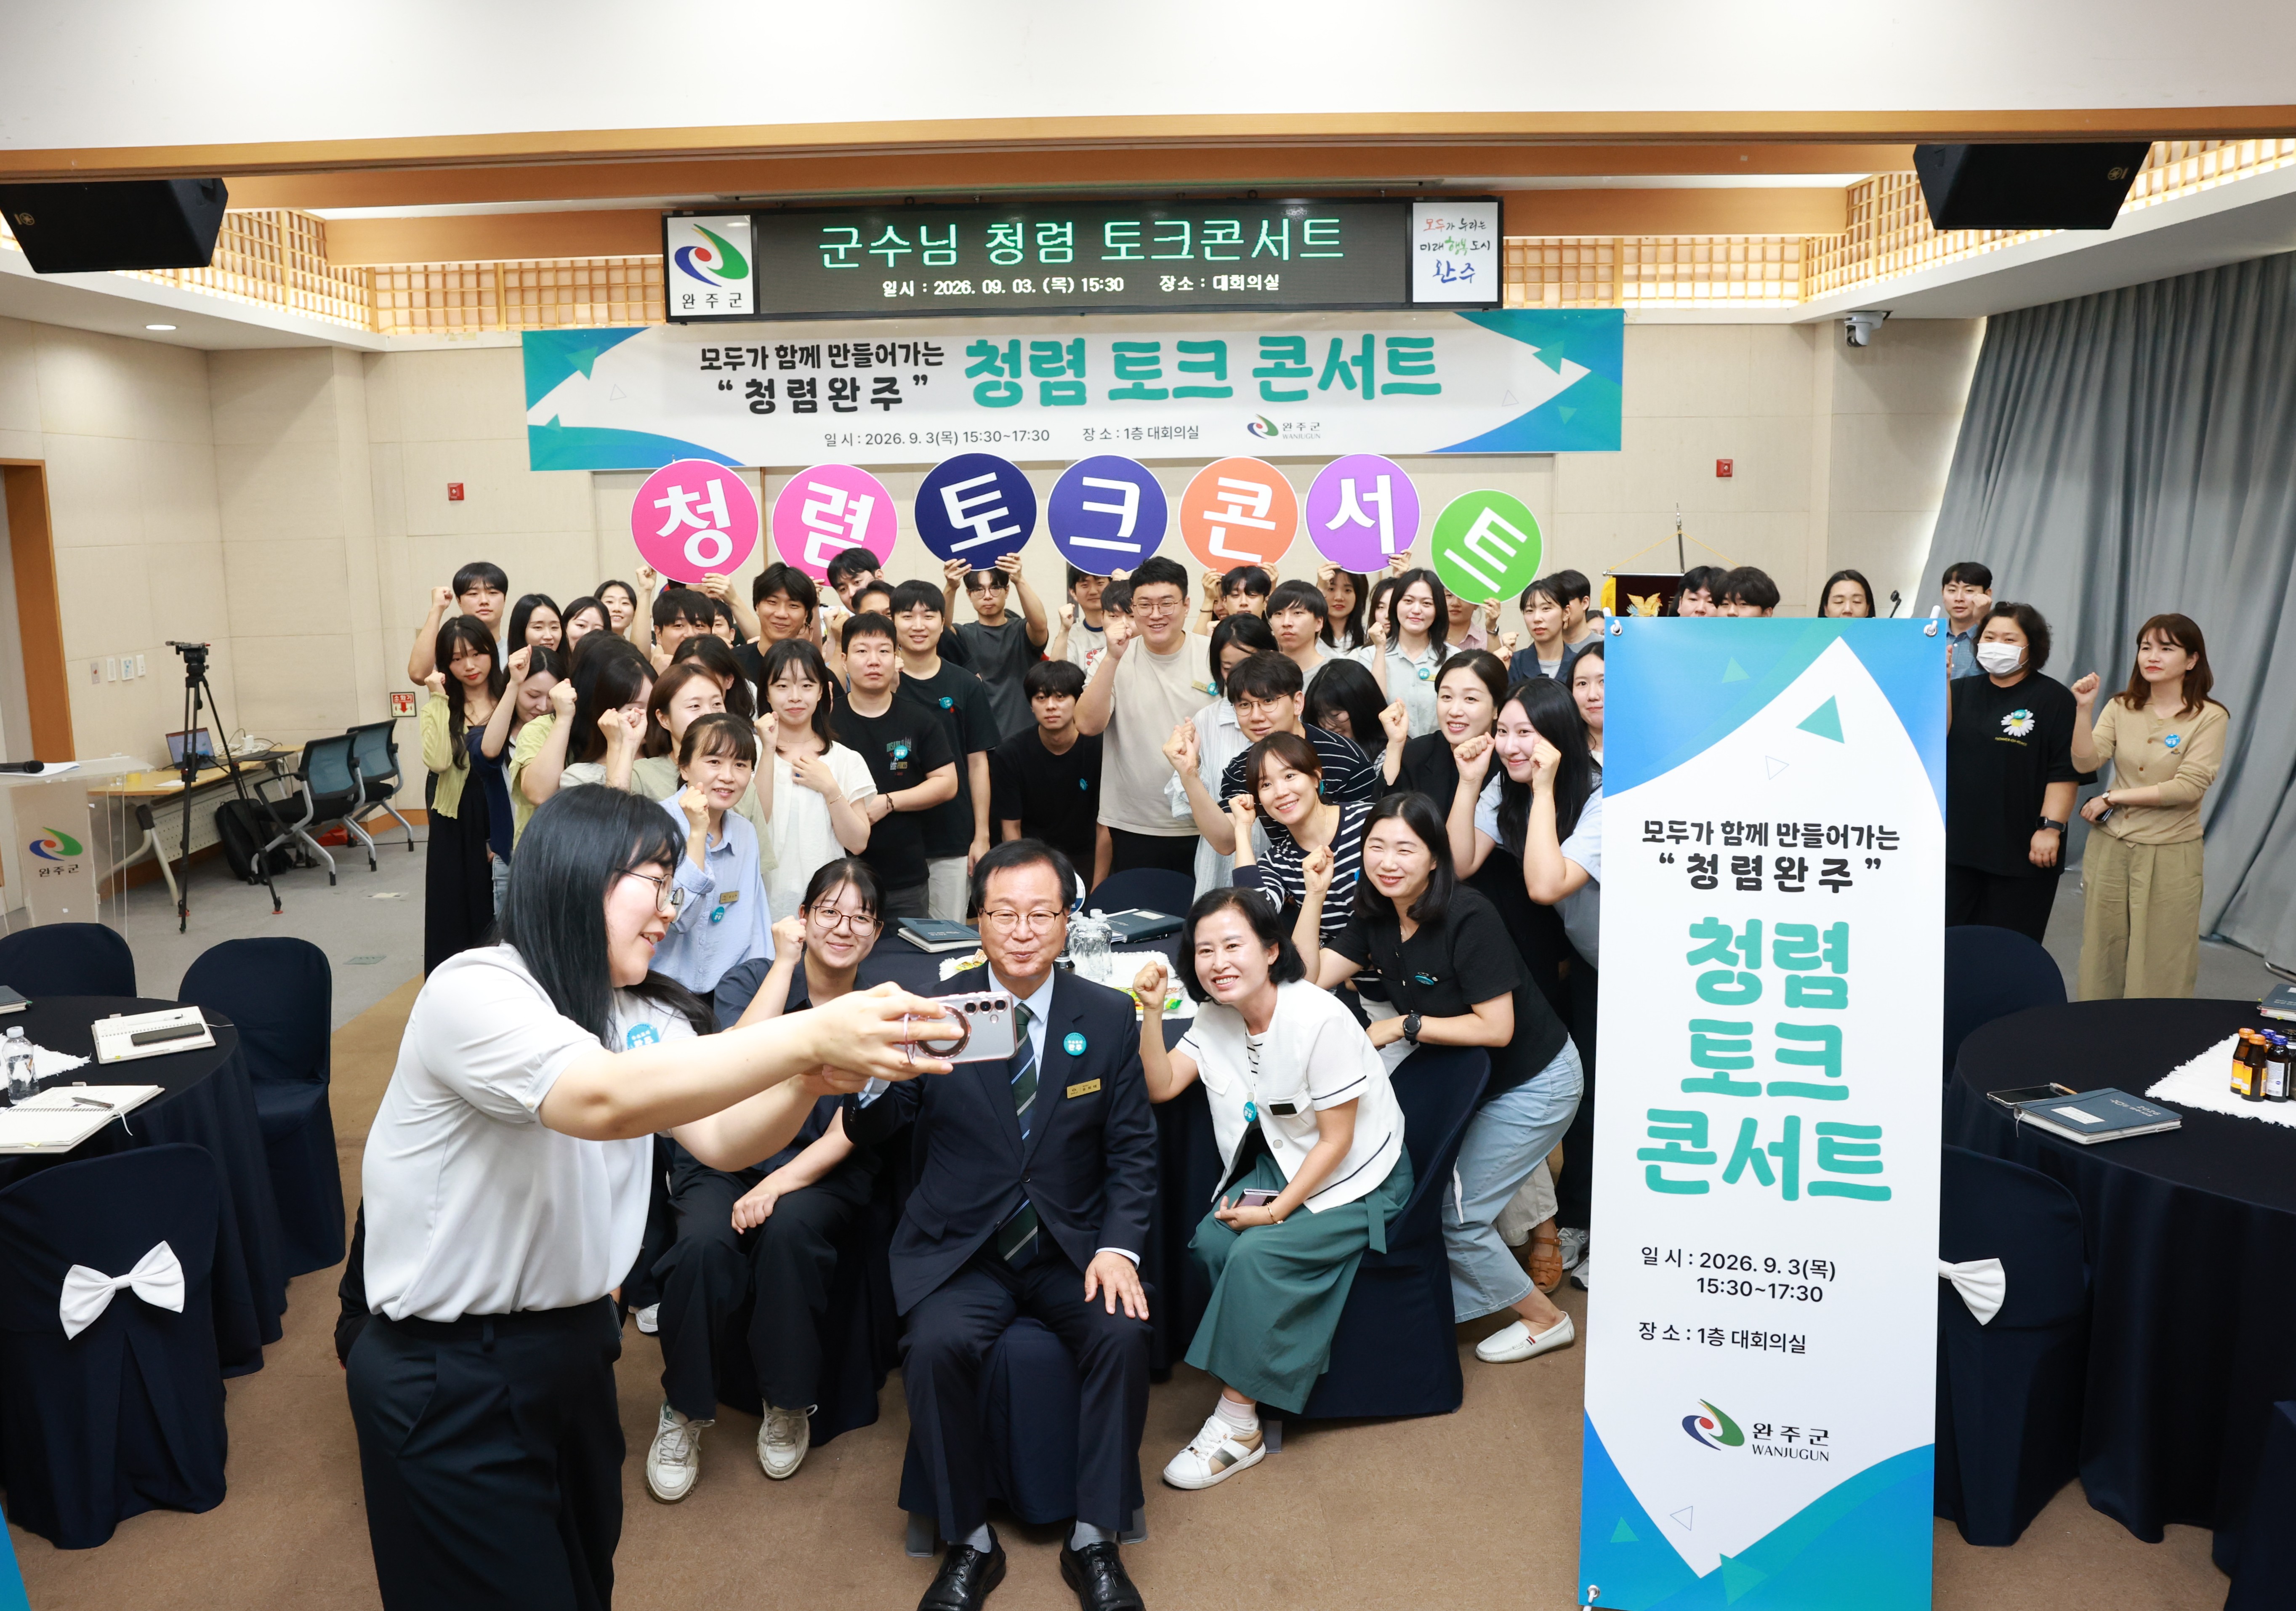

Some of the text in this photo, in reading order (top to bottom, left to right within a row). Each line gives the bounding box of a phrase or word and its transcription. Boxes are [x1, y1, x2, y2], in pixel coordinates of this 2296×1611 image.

[819, 218, 1344, 268] 군수님 청렴 토크콘서트
[1423, 218, 1487, 232] 모두가 누리는
[882, 280, 915, 298] 일시
[933, 280, 976, 296] 2026.
[982, 279, 1006, 294] 09.
[1012, 278, 1036, 294] 03.
[1042, 277, 1075, 294] (목)
[1081, 277, 1124, 293] 15:30
[1159, 275, 1194, 293] 장소
[1212, 274, 1280, 292] 대회의실
[1432, 259, 1476, 283] 완주
[700, 341, 944, 372] 모두가 함께 만들어가는
[965, 333, 1442, 408] 청렴 토크 콘서트
[865, 433, 905, 445] 2026.
[909, 433, 922, 444] 9.
[926, 431, 958, 446] 3(목)
[963, 430, 1050, 443] 15:30~17:30
[1124, 426, 1143, 440] 1층
[1147, 425, 1199, 440] 대회의실
[654, 478, 733, 567] 청
[801, 481, 875, 568] 렴
[940, 471, 1022, 552] 토
[1070, 476, 1141, 554] 크
[1203, 477, 1276, 563] 콘
[1325, 474, 1396, 555] 서
[1443, 506, 1528, 593] 트
[1642, 820, 1900, 851] 모두가 함께 만들어가는
[1686, 916, 1850, 1010] 청렴
[1681, 1018, 1850, 1101] 토크
[1636, 1108, 1892, 1202] 콘서트
[1699, 1252, 1757, 1272] 2026.
[1764, 1257, 1781, 1274] 9.
[1788, 1259, 1836, 1282] 3(목)
[1697, 1277, 1823, 1303] 15:30~17:30
[1697, 1327, 1726, 1347] 1층
[1731, 1329, 1806, 1355] 대회의실
[1752, 1444, 1829, 1462] WANJUGUN
